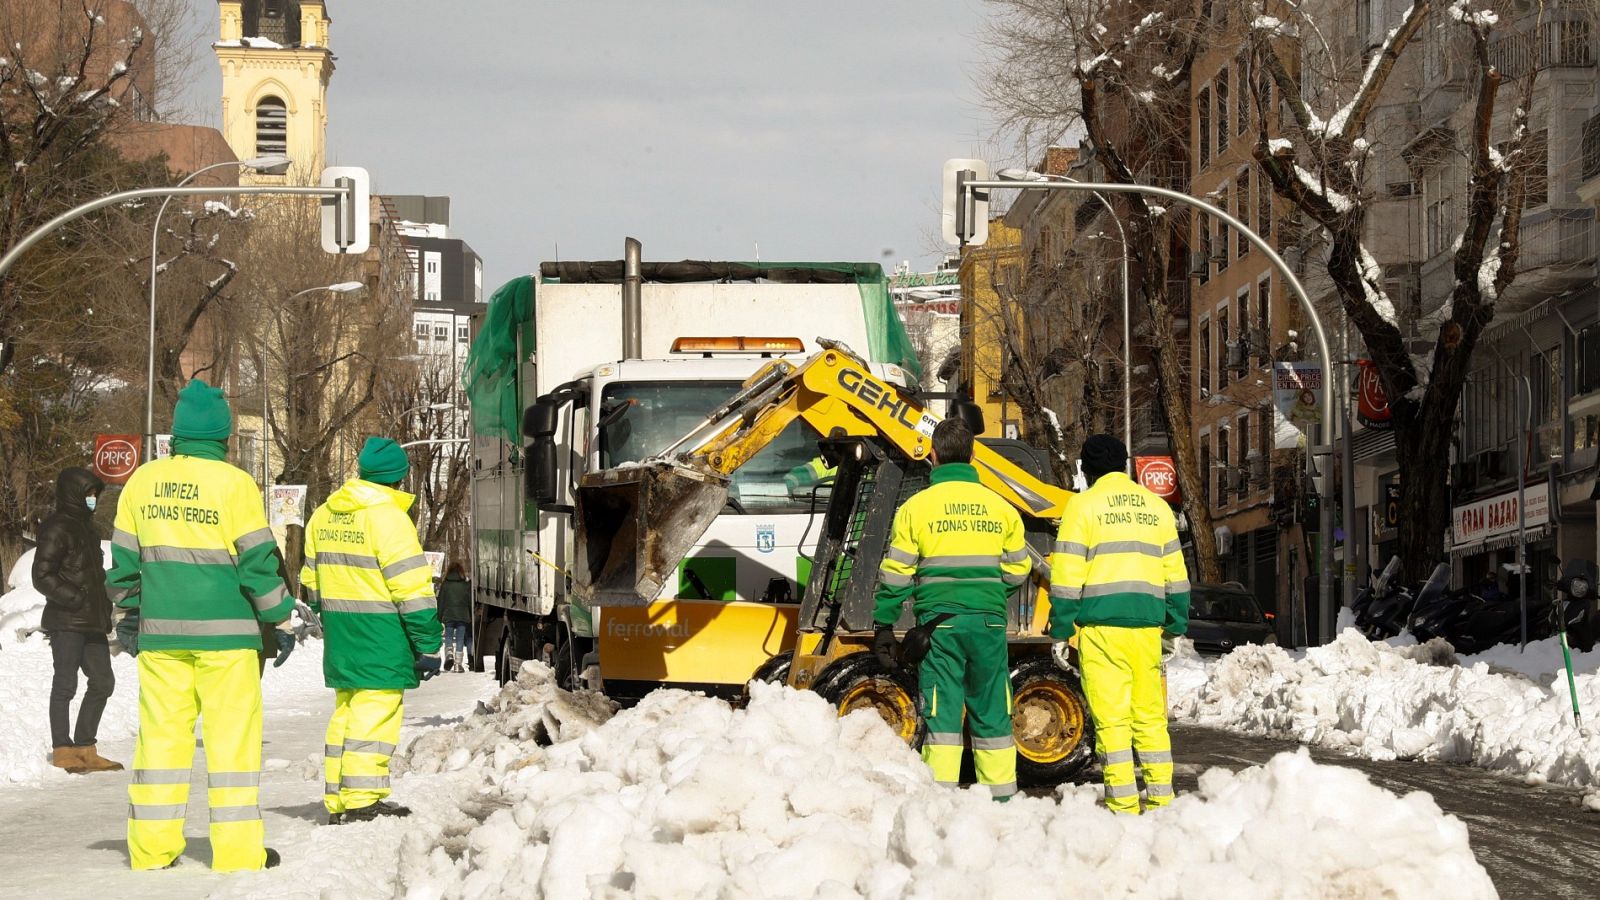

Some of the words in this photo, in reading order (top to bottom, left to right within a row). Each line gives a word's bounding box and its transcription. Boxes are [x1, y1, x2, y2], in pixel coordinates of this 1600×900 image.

[837, 367, 915, 431] GEHL
[100, 451, 131, 466] PRICE
[1145, 471, 1174, 487] PRICE
[154, 481, 199, 501] LIMPIEZA
[1106, 493, 1146, 508] LIMPIEZA
[140, 505, 146, 521] Y
[147, 504, 179, 521] ZONAS
[180, 506, 219, 526] VERDES
[944, 503, 989, 516] LIMPIEZA
[1461, 506, 1485, 537] GRAN
[1488, 497, 1518, 530] BAZAR
[927, 521, 934, 535] Y
[936, 519, 968, 533] ZONAS
[970, 519, 1003, 535] VERDES
[1096, 513, 1103, 527] Y
[1104, 511, 1132, 525] ZONAS
[607, 617, 691, 638] ferrovial
